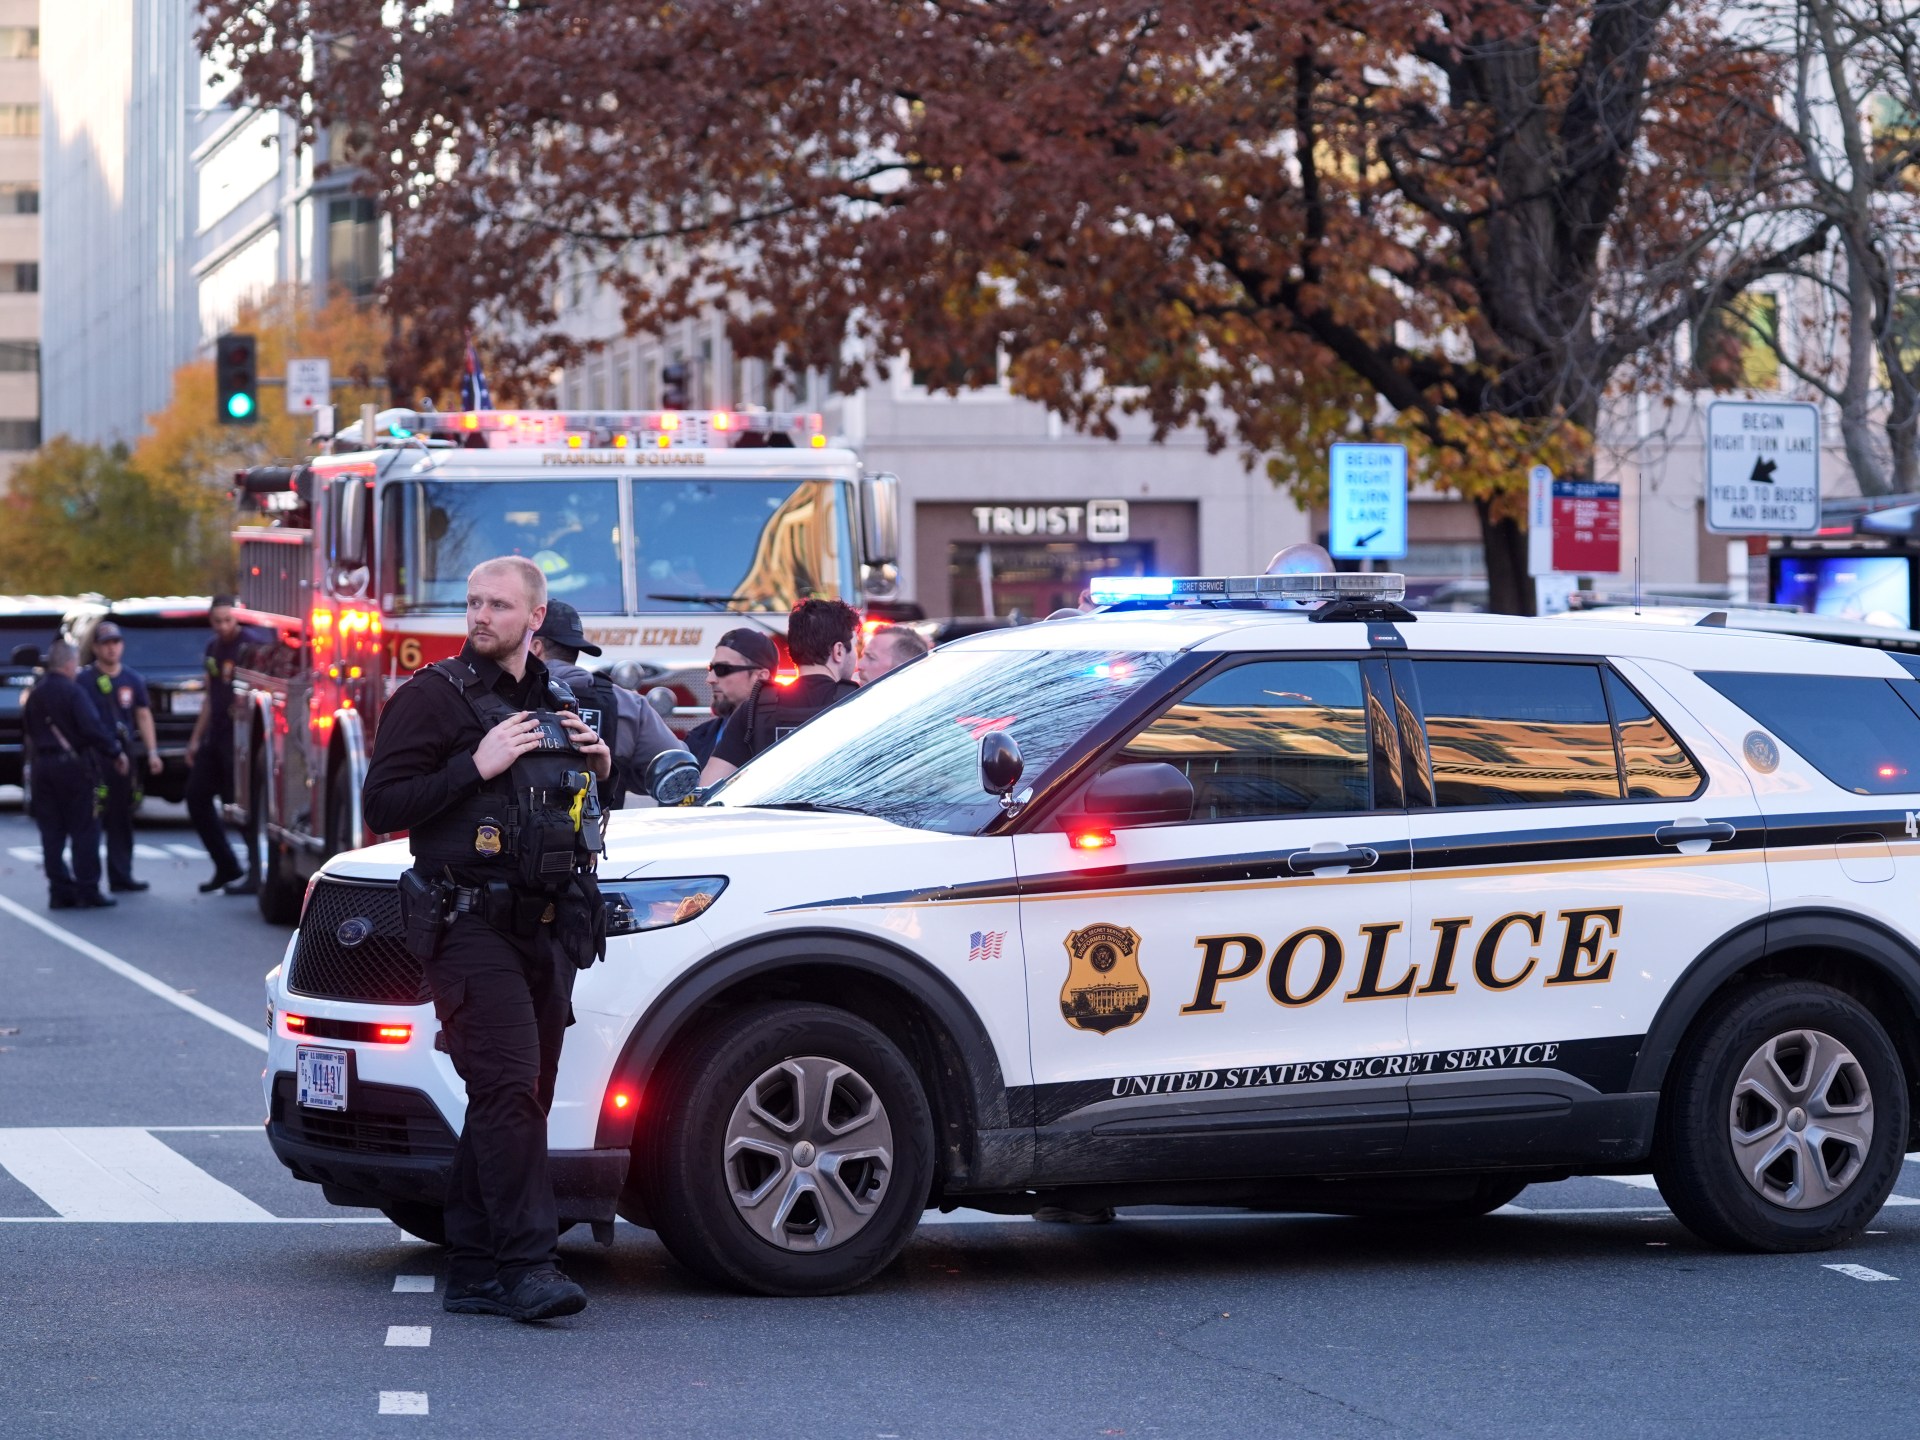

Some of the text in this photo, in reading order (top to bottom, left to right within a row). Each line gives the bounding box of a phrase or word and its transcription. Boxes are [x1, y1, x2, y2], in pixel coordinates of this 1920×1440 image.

[1742, 413, 1784, 430] BEGIN
[1714, 435, 1813, 452] RIGHT TURN LANE
[543, 453, 705, 465] FRANKLIN SQUARE
[1346, 452, 1392, 466] BEGIN
[1346, 471, 1390, 485] RIGHT
[1349, 489, 1390, 503] TURN
[1713, 486, 1815, 502] YIELD TO BUSES
[1347, 508, 1388, 522] LANE
[1730, 504, 1797, 520] AND BIKES
[972, 506, 1084, 535] TRUIST
[1176, 581, 1224, 591] SECRET SERVICE
[1088, 927, 1106, 936] SECRET
[1106, 927, 1126, 940] SERVICE
[1077, 934, 1129, 957] UNIFORMED DIVISION
[1178, 905, 1624, 1016] POLICE
[1111, 1043, 1560, 1097] UNITED STATES SECRET SERVICE
